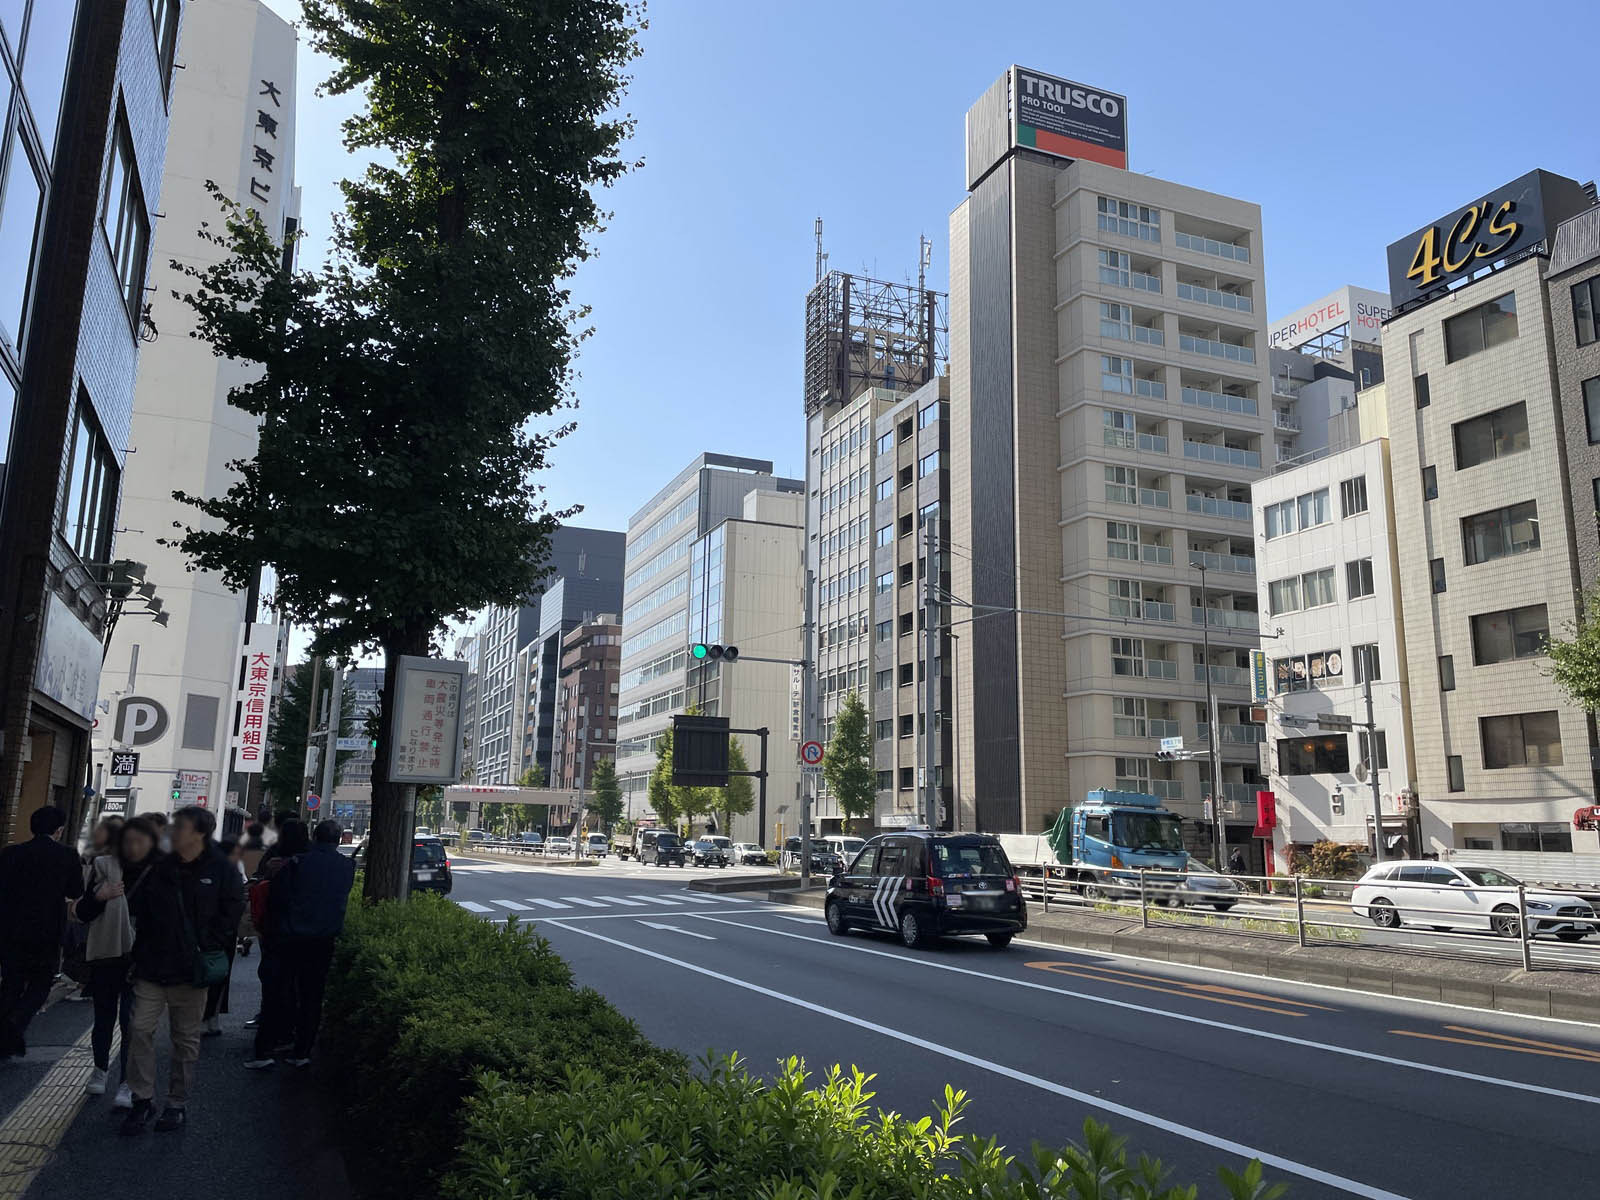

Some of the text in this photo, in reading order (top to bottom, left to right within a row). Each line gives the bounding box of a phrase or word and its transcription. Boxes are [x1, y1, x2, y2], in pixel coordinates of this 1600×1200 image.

[1021, 74, 1119, 118] TRUSCO
[1021, 95, 1066, 115] PRO TOOL
[250, 79, 281, 221] 大東京ビ
[1406, 200, 1520, 288] 4C's
[1357, 315, 1381, 329] HOT
[241, 651, 270, 760] 大東京信用組合
[447, 677, 458, 718] この通りは
[121, 703, 159, 745] P
[416, 679, 436, 768] 車両通行禁止
[429, 679, 448, 768] 大震災等発生時
[113, 754, 137, 774] 満
